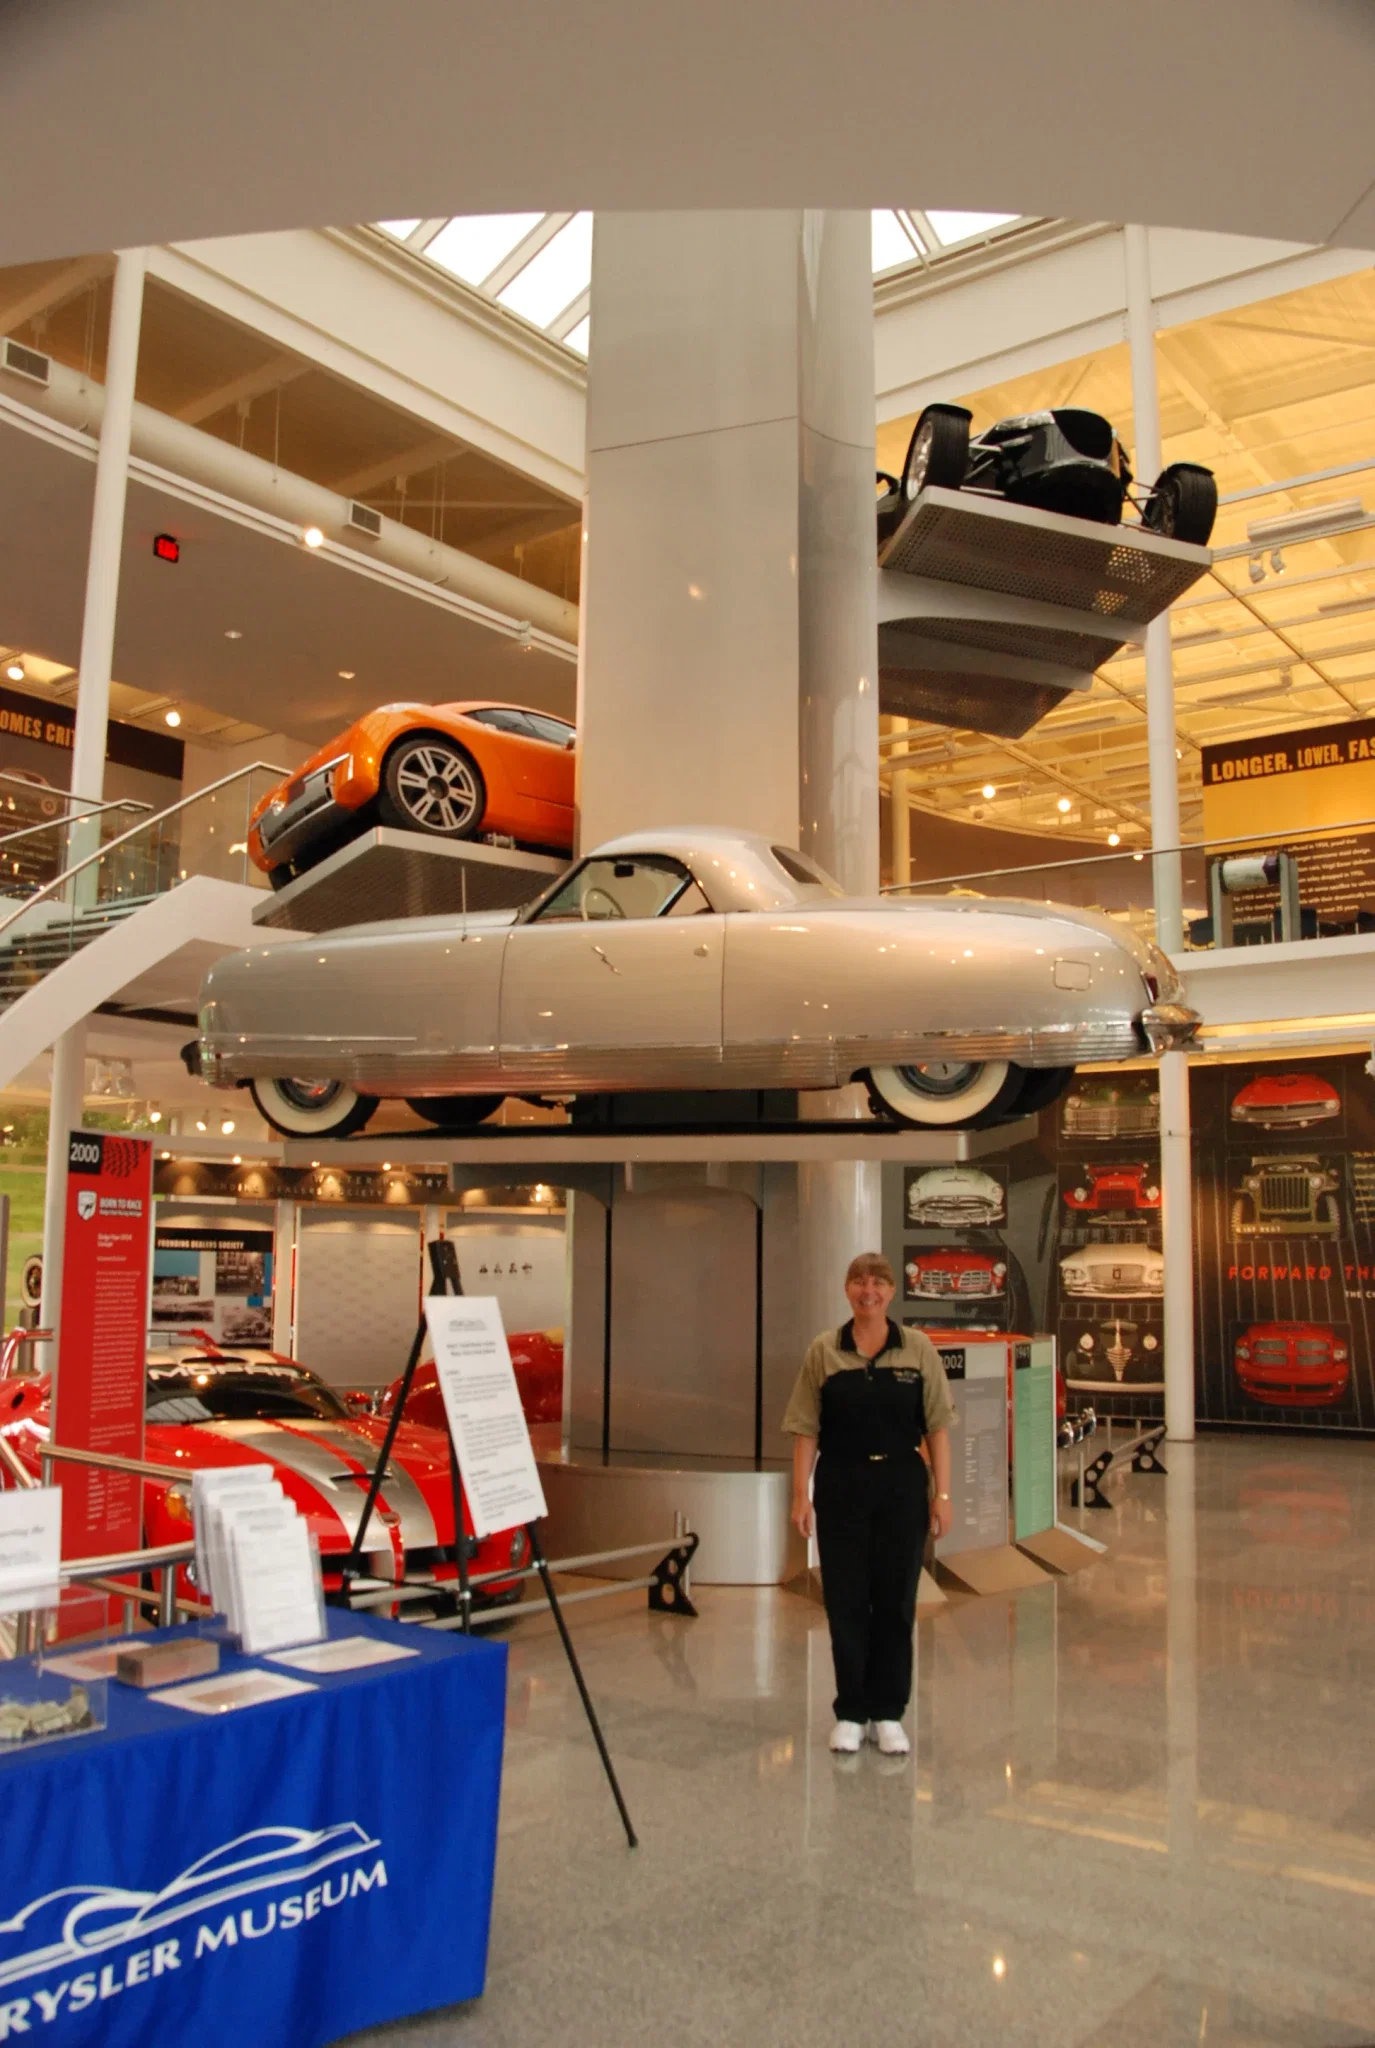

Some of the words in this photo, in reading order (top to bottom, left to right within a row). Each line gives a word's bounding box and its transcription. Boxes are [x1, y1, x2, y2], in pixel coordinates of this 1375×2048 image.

[1211, 752, 1293, 782] LONGER,
[1297, 743, 1344, 768] LOWER,
[70, 1142, 100, 1164] 2000
[1227, 1265, 1332, 1281] FORWARD
[940, 1354, 964, 1370] 002
[0, 1938, 182, 2041] RYSLER
[194, 1859, 389, 1960] MUSEUM
